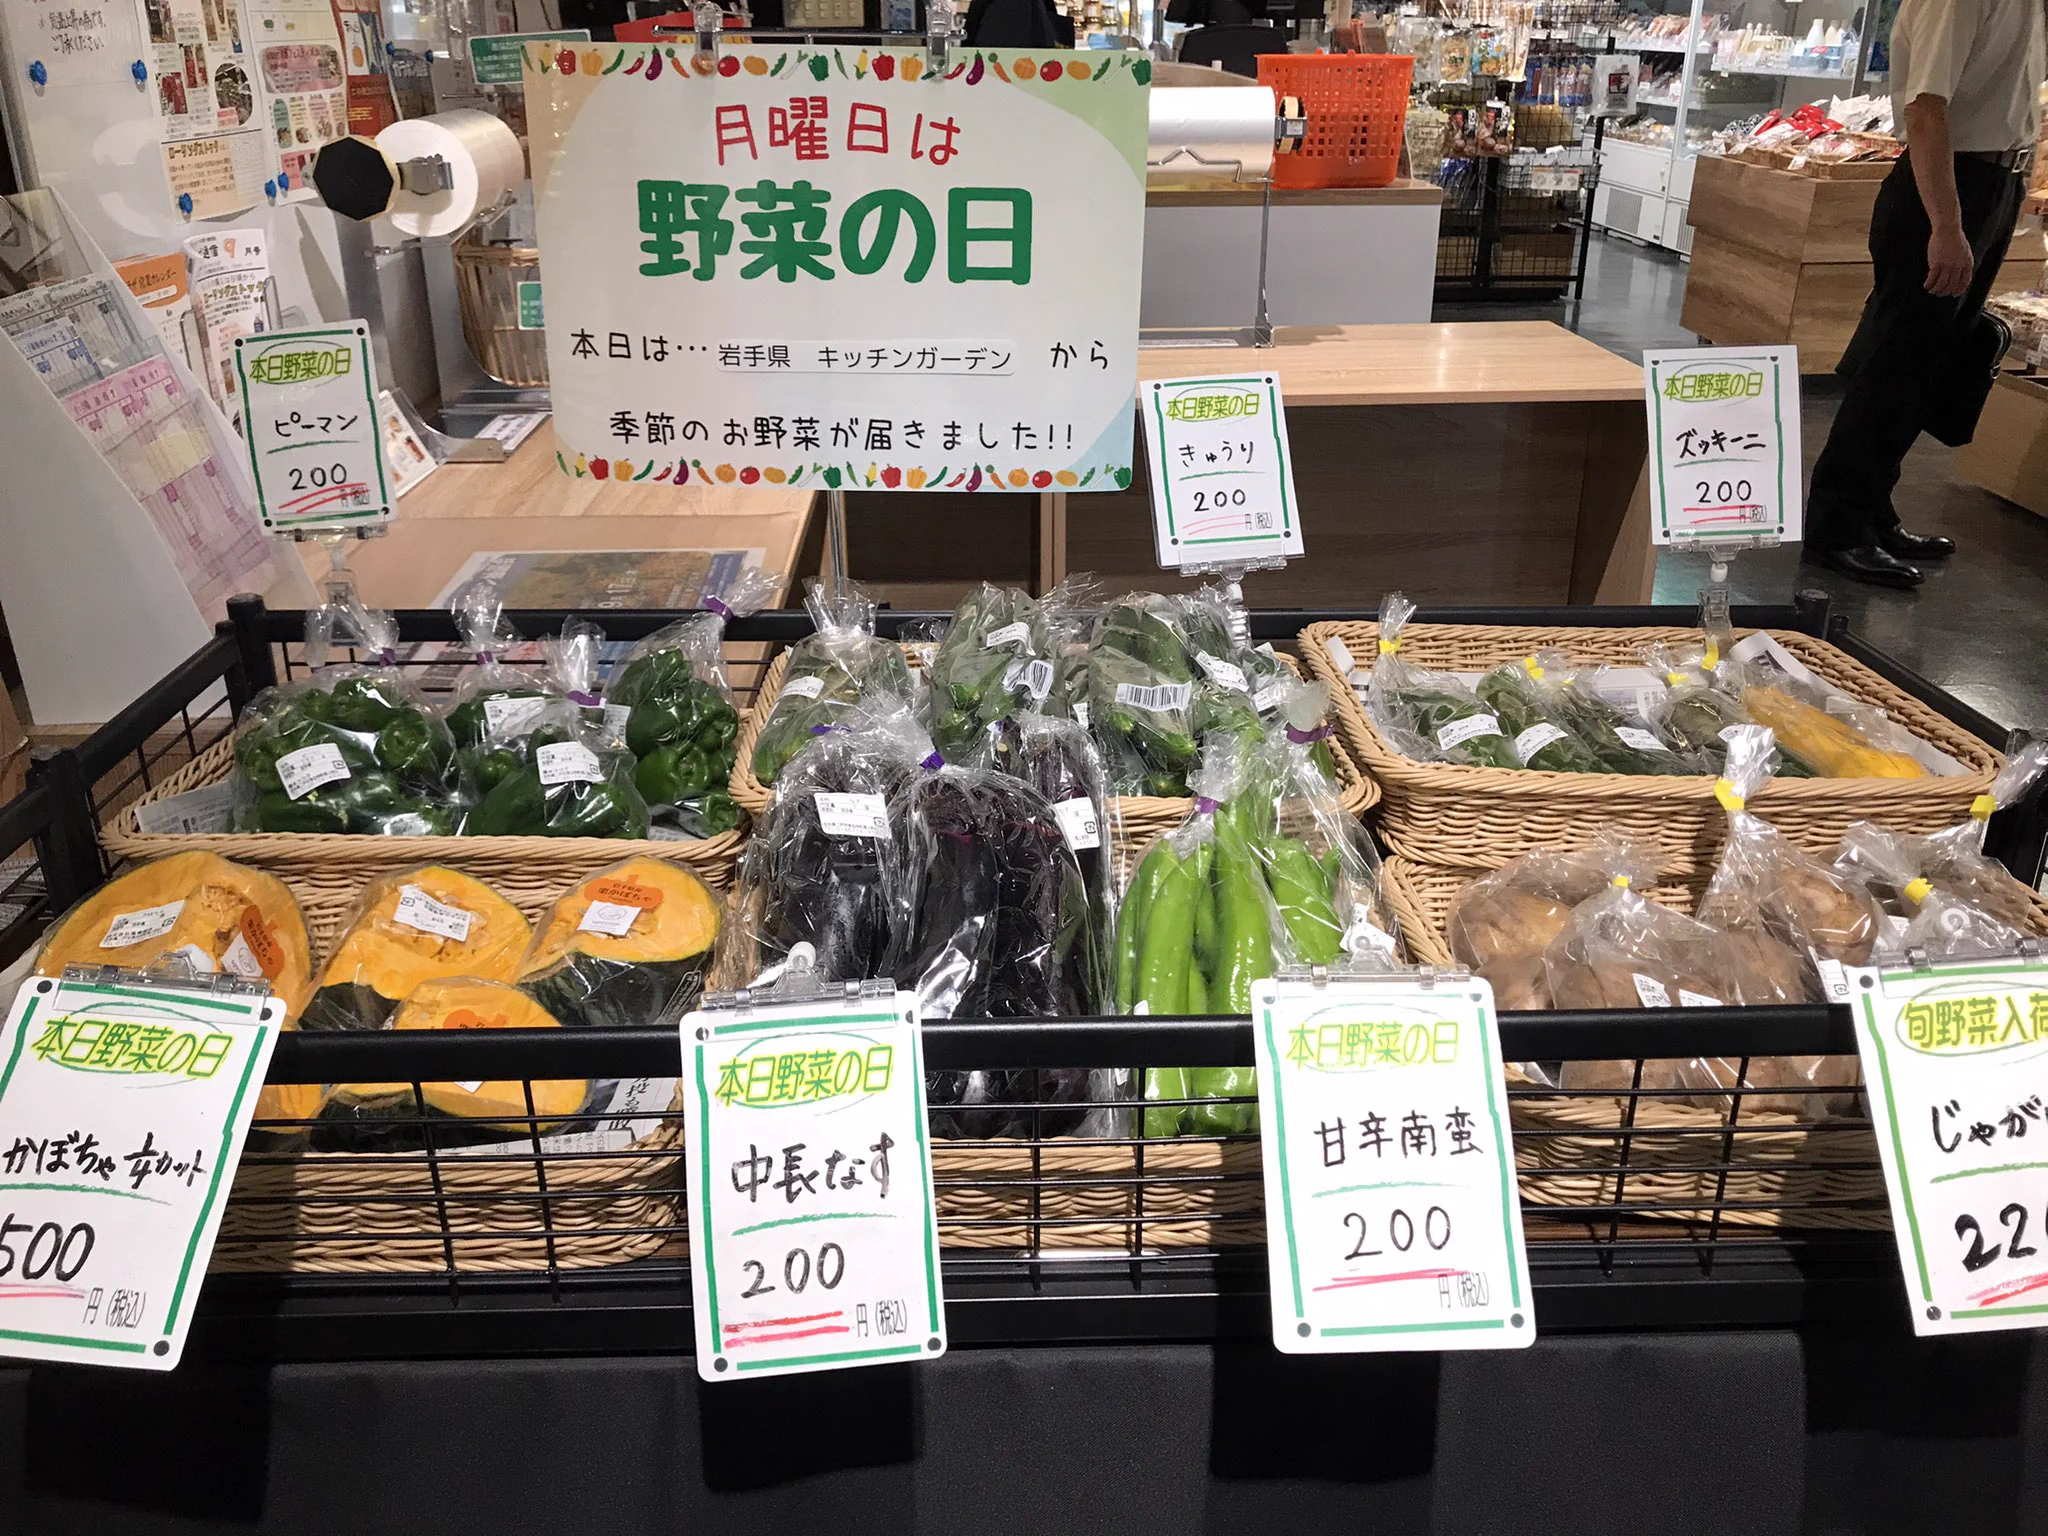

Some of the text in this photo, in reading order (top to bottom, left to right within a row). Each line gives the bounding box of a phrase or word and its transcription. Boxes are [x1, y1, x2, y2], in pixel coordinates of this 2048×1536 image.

[714, 96, 961, 166] 月曜日は
[638, 180, 1032, 285] 野菜の日
[250, 348, 351, 384] 本日野菜の日
[718, 344, 792, 369] 岩手県
[816, 345, 1012, 372] キッチンガーデン
[1050, 341, 1109, 371] から
[1166, 393, 1260, 420] 本日野菜の日
[1664, 372, 1763, 400] 本日野菜の日
[275, 411, 358, 437] ピーマン
[610, 411, 1075, 453] 季節のお野菜が届きました!!
[1675, 428, 1766, 458] ズッキーニ
[289, 463, 347, 490] 200
[1178, 441, 1253, 467] きゅうり
[1194, 489, 1246, 512] 200
[1696, 480, 1751, 503] 200
[33, 1016, 233, 1078] 本日野菜の日
[1287, 1021, 1459, 1069] 本日野菜の日
[716, 1045, 893, 1106] 本日野菜の日
[1313, 1106, 1483, 1168] 甘辛南蛮
[1930, 1094, 2048, 1154] じゃが
[3, 1130, 117, 1181] かぼちゃ
[731, 1131, 895, 1204] 中長なす
[0, 1213, 96, 1281] 500
[1343, 1205, 1452, 1261] 200
[1954, 1202, 2048, 1273] 22
[740, 1242, 846, 1299] 200
